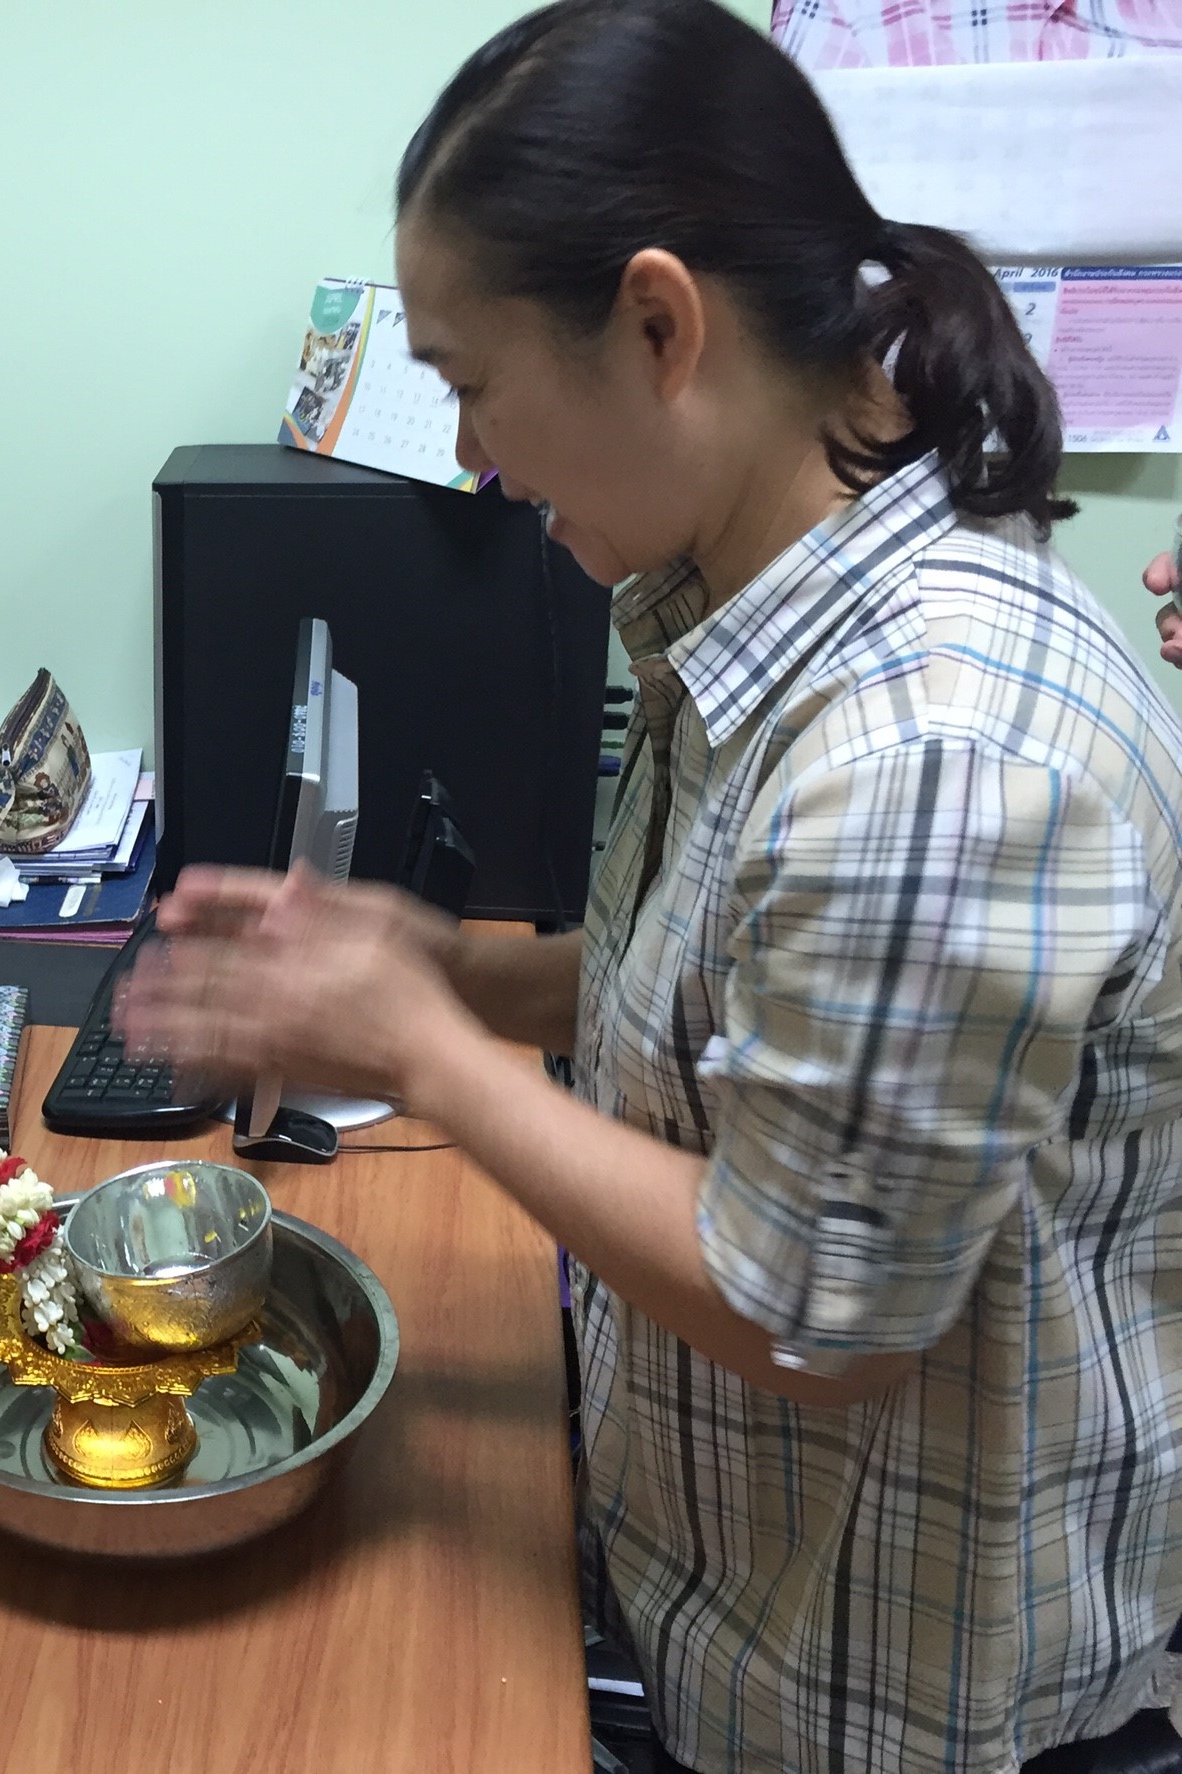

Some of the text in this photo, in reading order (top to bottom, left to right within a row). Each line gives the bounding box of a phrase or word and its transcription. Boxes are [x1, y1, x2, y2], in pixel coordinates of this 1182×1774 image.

[993, 267, 1024, 280] April
[1030, 267, 1059, 278] 2016
[1025, 302, 1037, 316] 2
